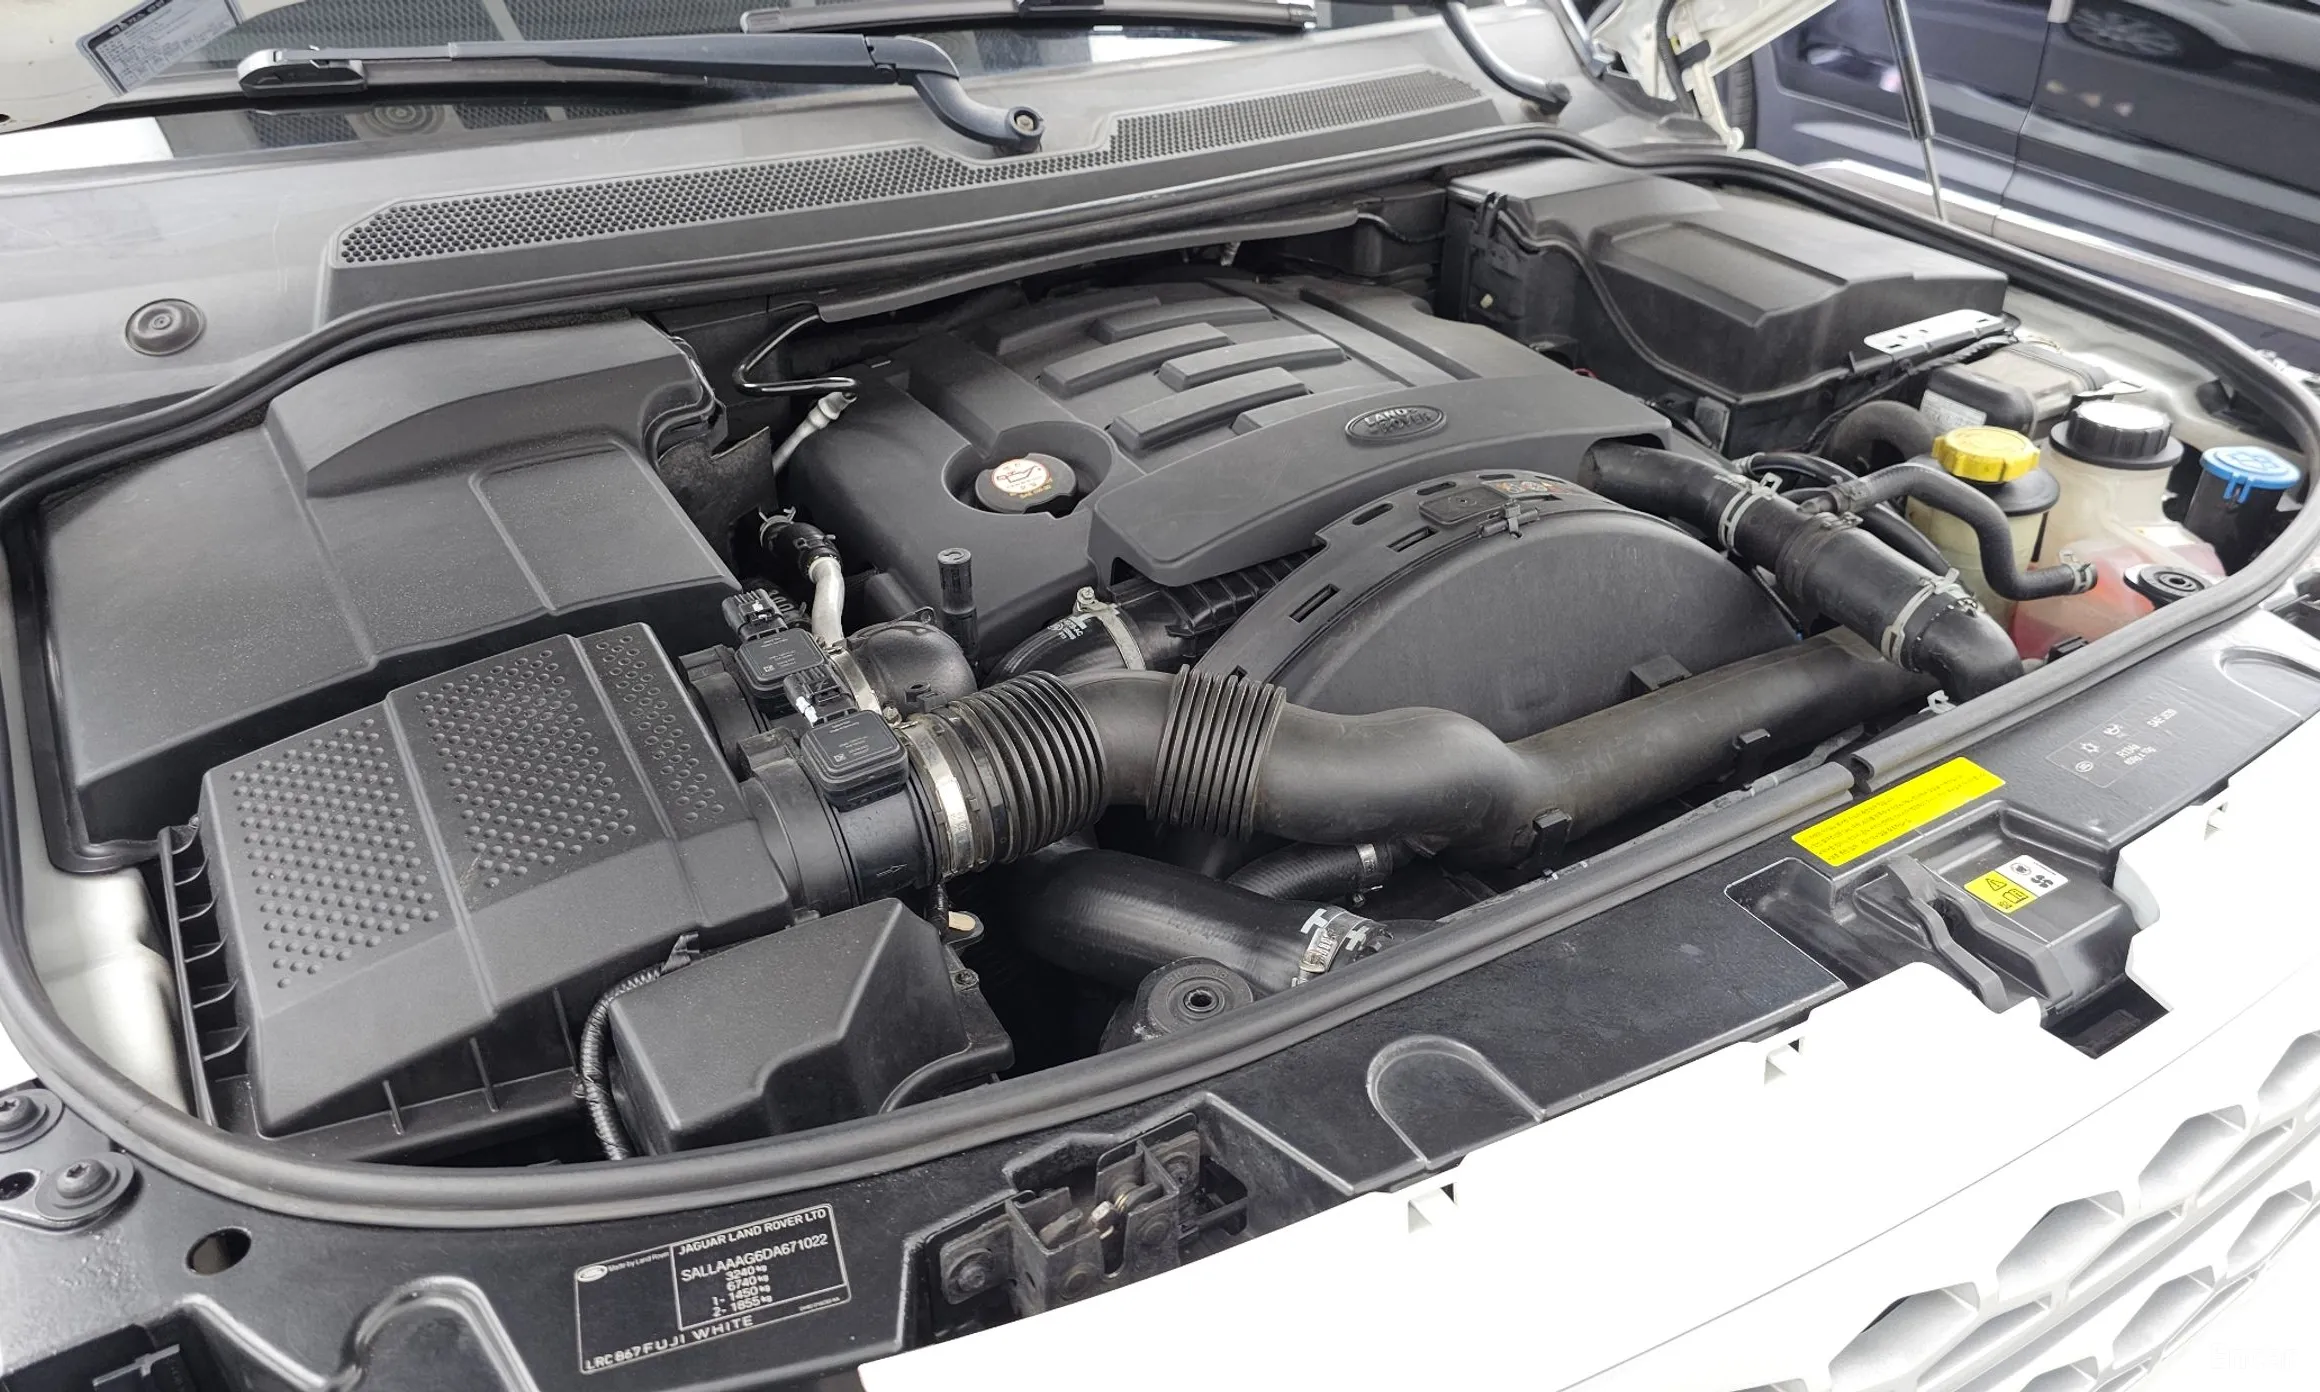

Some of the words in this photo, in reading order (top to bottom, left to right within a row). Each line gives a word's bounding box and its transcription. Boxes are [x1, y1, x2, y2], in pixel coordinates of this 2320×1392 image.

[1364, 408, 1408, 427] LAND
[1380, 412, 1432, 433] ROVER
[678, 1234, 727, 1256] JAGUAR
[728, 1225, 763, 1242] LAND
[764, 1214, 804, 1233] ROVER
[804, 1208, 827, 1223] LTD
[680, 1233, 829, 1282] SALLAAAG6DA671022
[725, 1265, 755, 1281] 3240
[726, 1275, 757, 1291] 6740
[728, 1286, 759, 1302] 1450
[730, 1296, 761, 1312] 1855
[691, 1314, 754, 1341] WHITE
